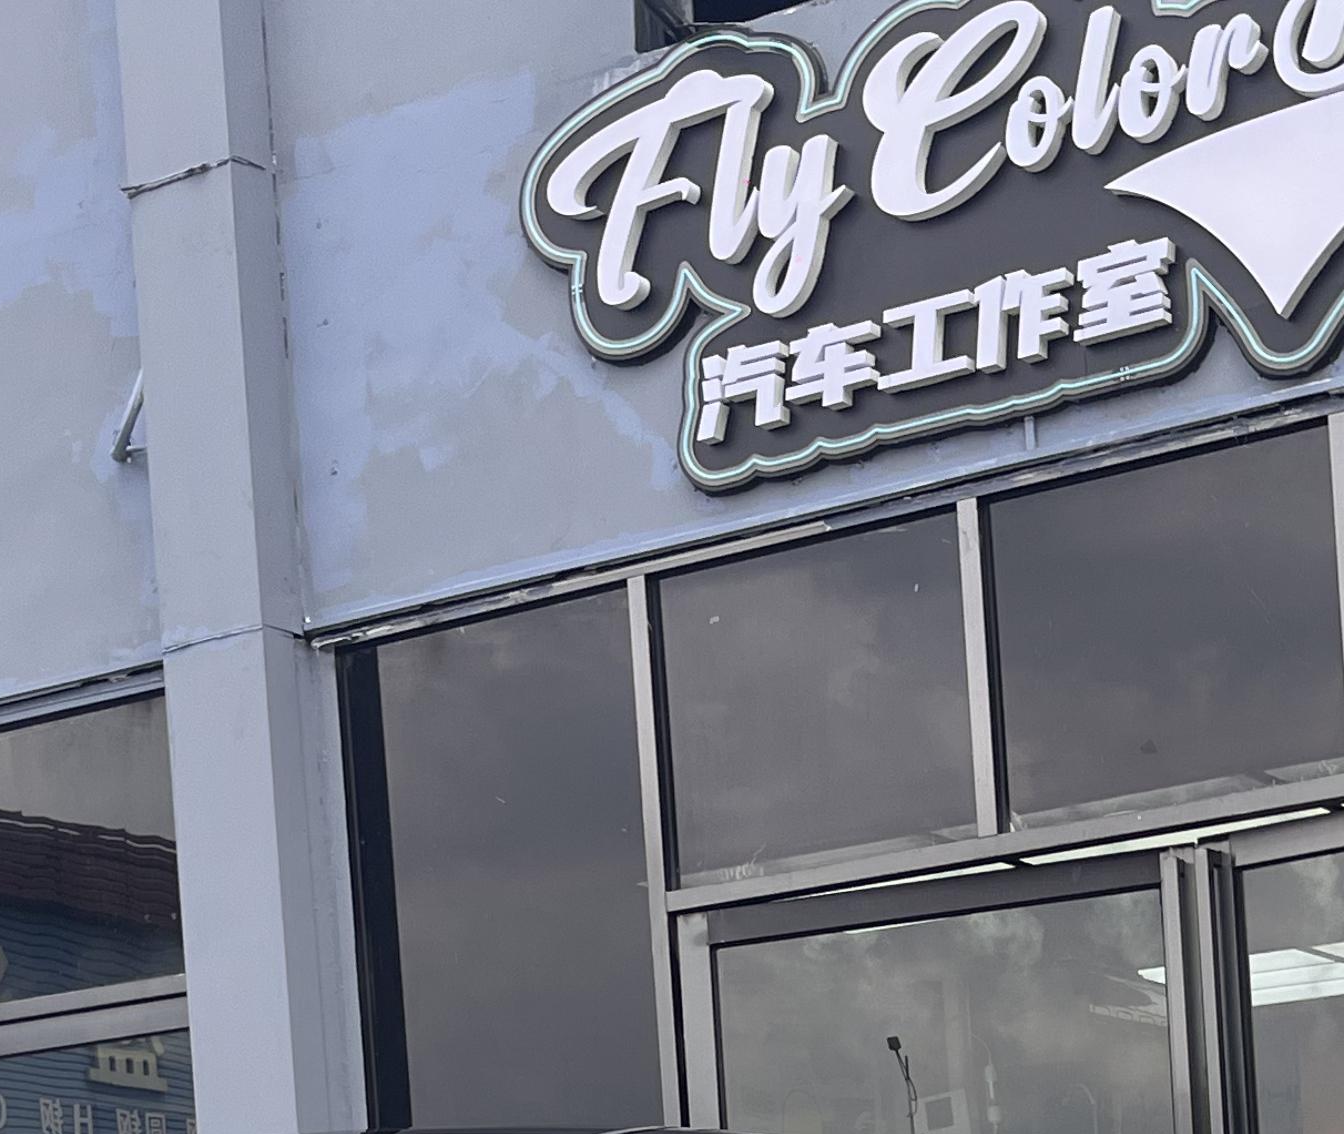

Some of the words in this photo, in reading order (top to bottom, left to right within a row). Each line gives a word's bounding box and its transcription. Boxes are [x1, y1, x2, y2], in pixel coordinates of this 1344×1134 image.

[547, 68, 851, 317] Fly
[696, 238, 1176, 445] 汽车工作室
